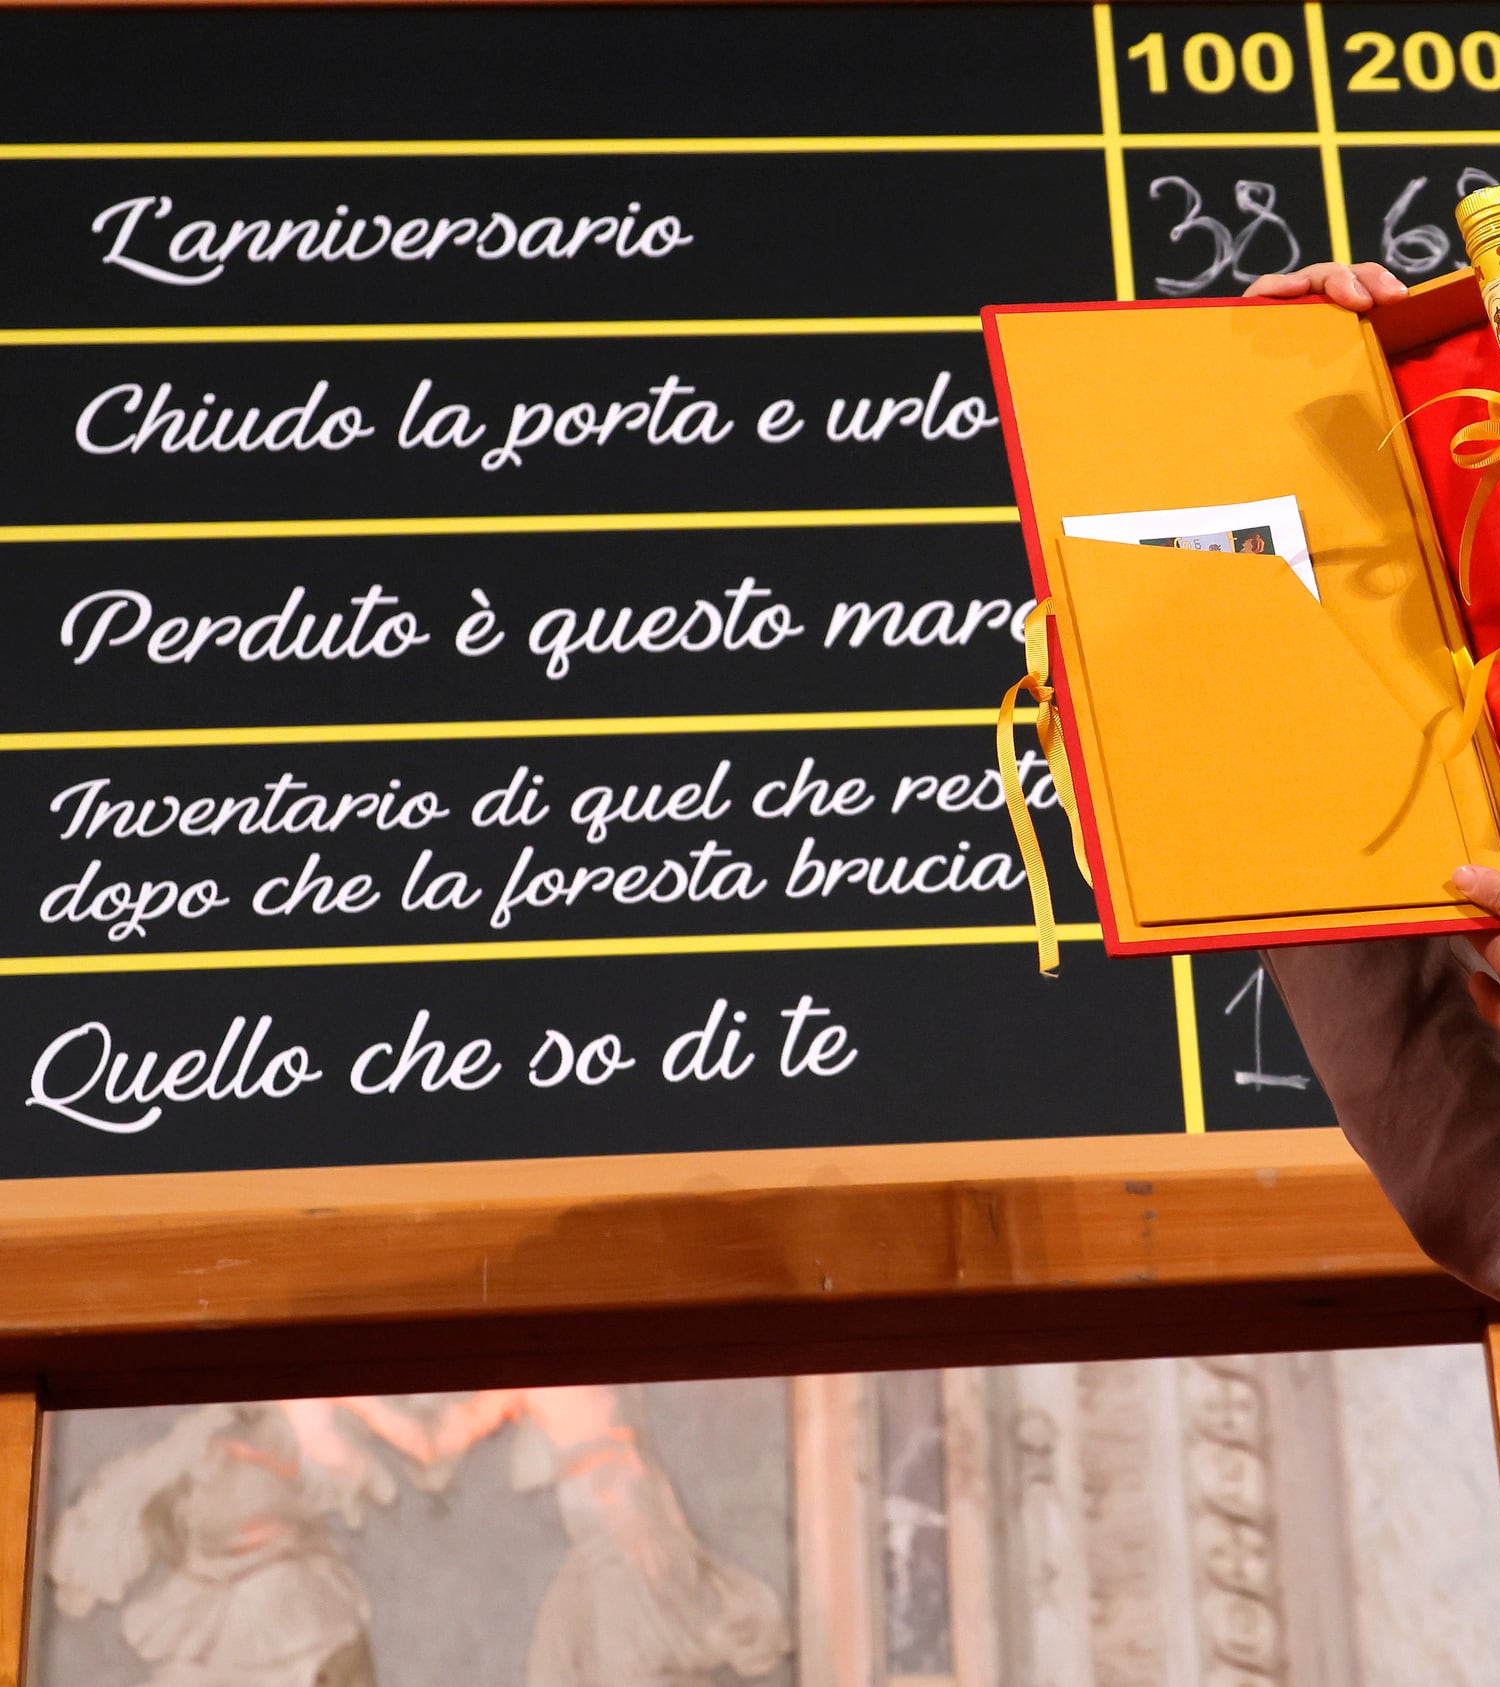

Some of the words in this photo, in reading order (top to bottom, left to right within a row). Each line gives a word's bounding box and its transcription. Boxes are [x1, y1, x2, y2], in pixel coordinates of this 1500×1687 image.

[1127, 32, 1294, 93] 100
[91, 195, 694, 286] L'anniversario
[1149, 175, 1300, 296] 38
[75, 379, 375, 455] Chiudo
[397, 378, 486, 450] la
[481, 374, 735, 472] porta
[756, 399, 805, 444] e
[826, 370, 1000, 442] urlo
[60, 583, 431, 665] Perduto
[455, 587, 506, 657] è
[528, 576, 805, 680] questo
[49, 772, 451, 840] Inventario
[471, 765, 550, 828] di
[570, 760, 732, 844] quel
[751, 756, 876, 819] che
[39, 859, 231, 942] dopo
[252, 852, 381, 916] che
[401, 848, 483, 912] la
[489, 840, 768, 930] foresta
[785, 836, 1027, 899] brucia
[24, 1014, 324, 1134] Quello
[349, 1008, 503, 1095] che
[528, 1029, 637, 1088] so
[661, 997, 756, 1083] di
[779, 994, 859, 1078] te
